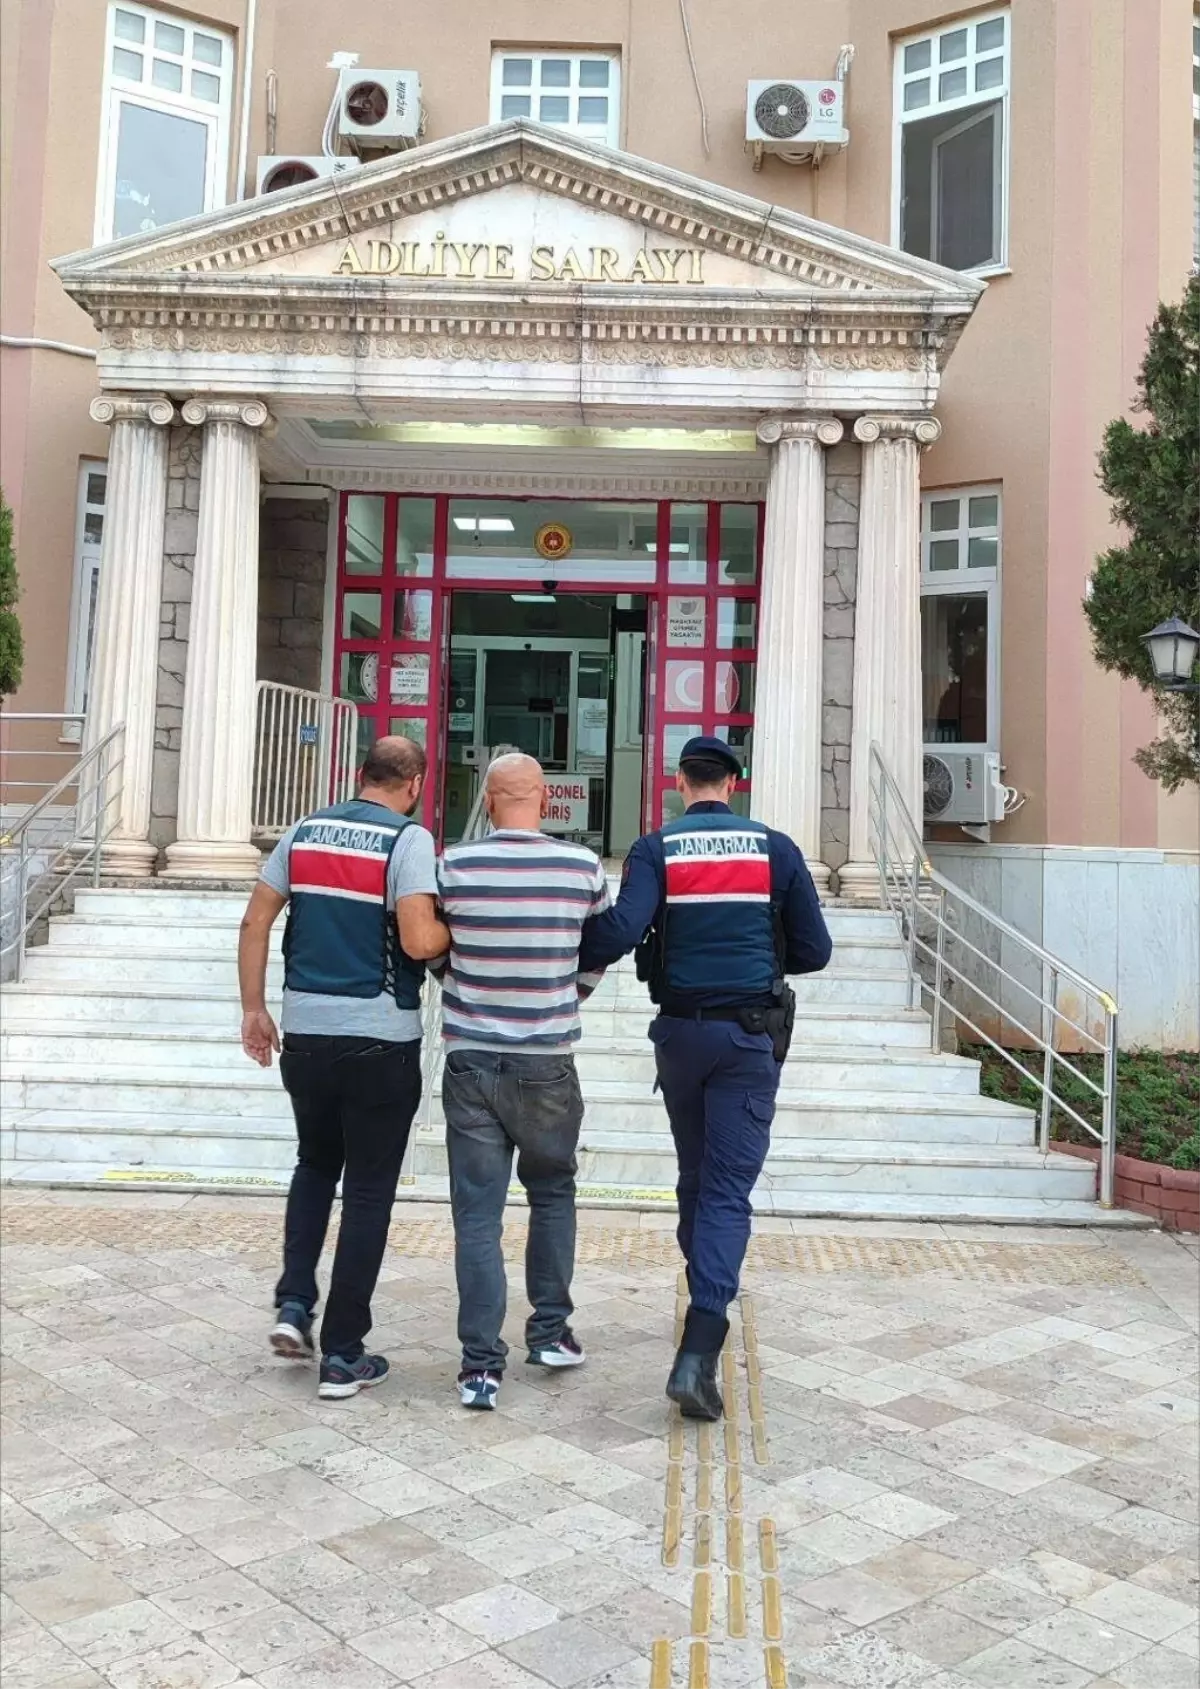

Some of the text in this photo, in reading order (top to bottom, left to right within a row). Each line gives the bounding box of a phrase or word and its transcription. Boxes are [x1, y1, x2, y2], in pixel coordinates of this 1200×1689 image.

[819, 108, 834, 117] LG
[332, 231, 705, 284] ADLİYE SARAYI
[543, 784, 587, 800] SONEL
[303, 825, 384, 852] JANDARMA
[675, 836, 759, 856] JANDARMA
